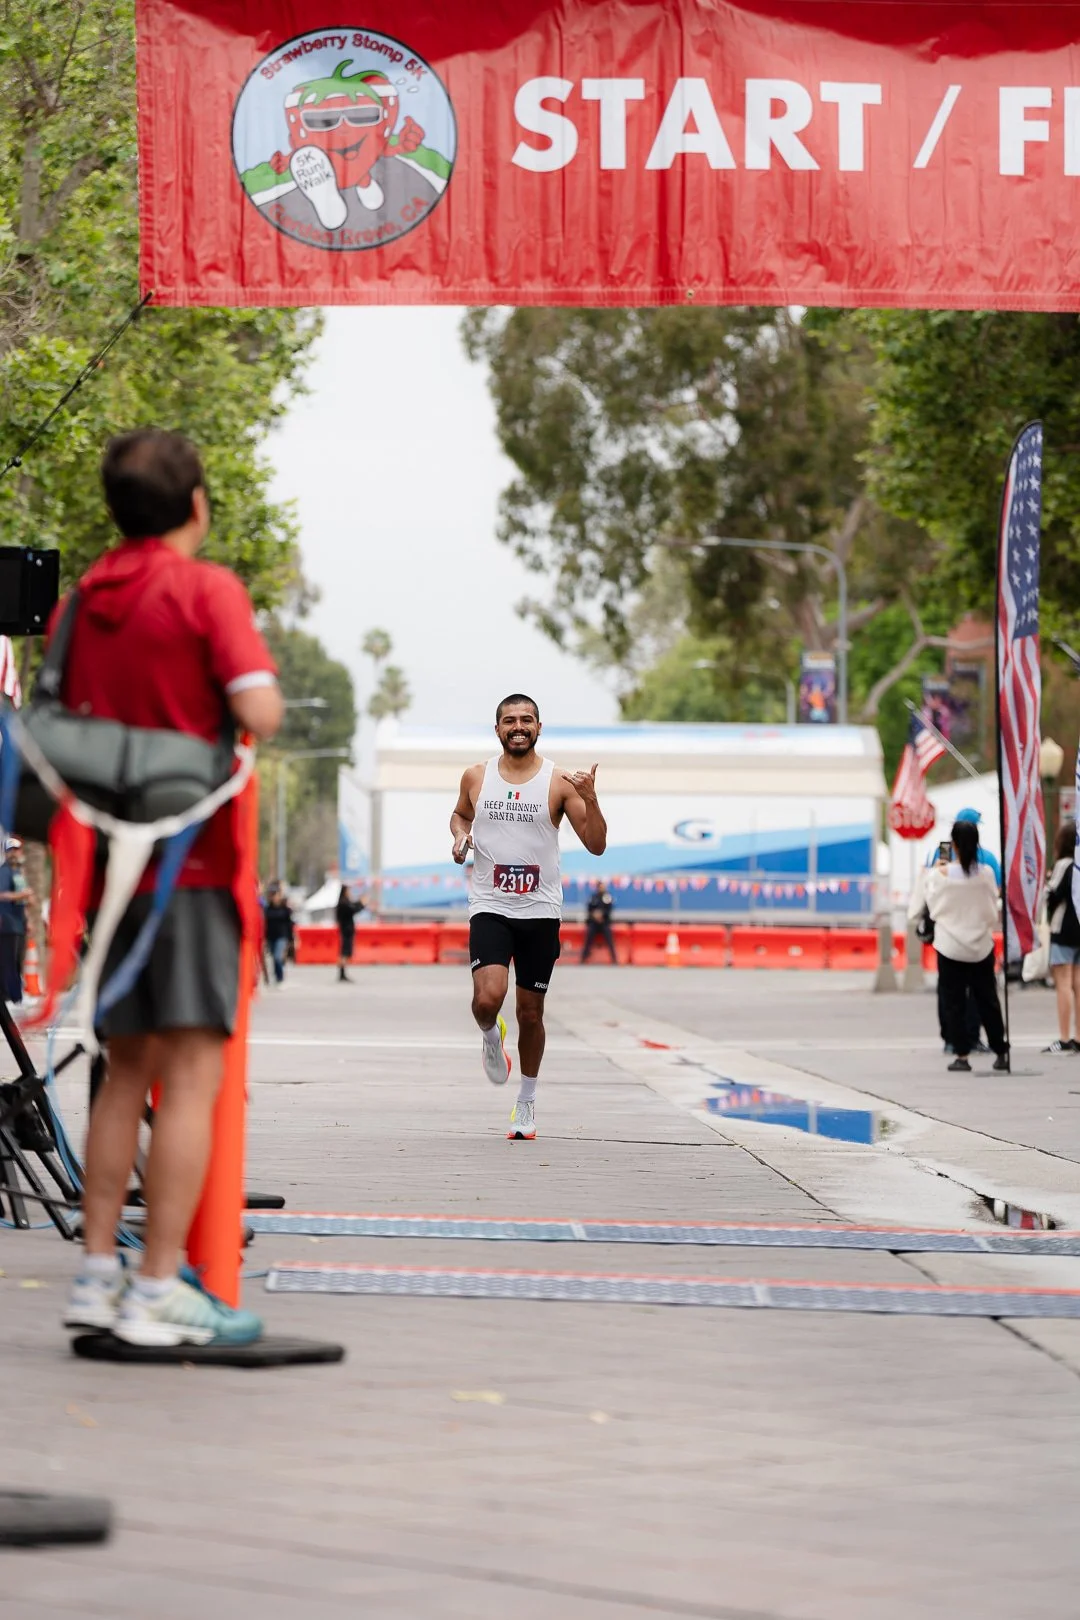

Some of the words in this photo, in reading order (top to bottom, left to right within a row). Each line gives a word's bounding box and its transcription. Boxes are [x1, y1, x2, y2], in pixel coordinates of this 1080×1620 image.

[260, 34, 347, 80] Strawberry
[352, 33, 403, 63] Stomp
[404, 58, 429, 81] 5K
[511, 76, 882, 173] START
[913, 84, 962, 169] /
[296, 151, 317, 167] 5K
[299, 171, 332, 190] Walk
[268, 203, 334, 243] Garden
[401, 197, 429, 222] CA
[484, 800, 504, 810] KEEP
[488, 811, 515, 822] SANTA
[516, 813, 534, 823] ANA
[499, 872, 534, 892] 2319
